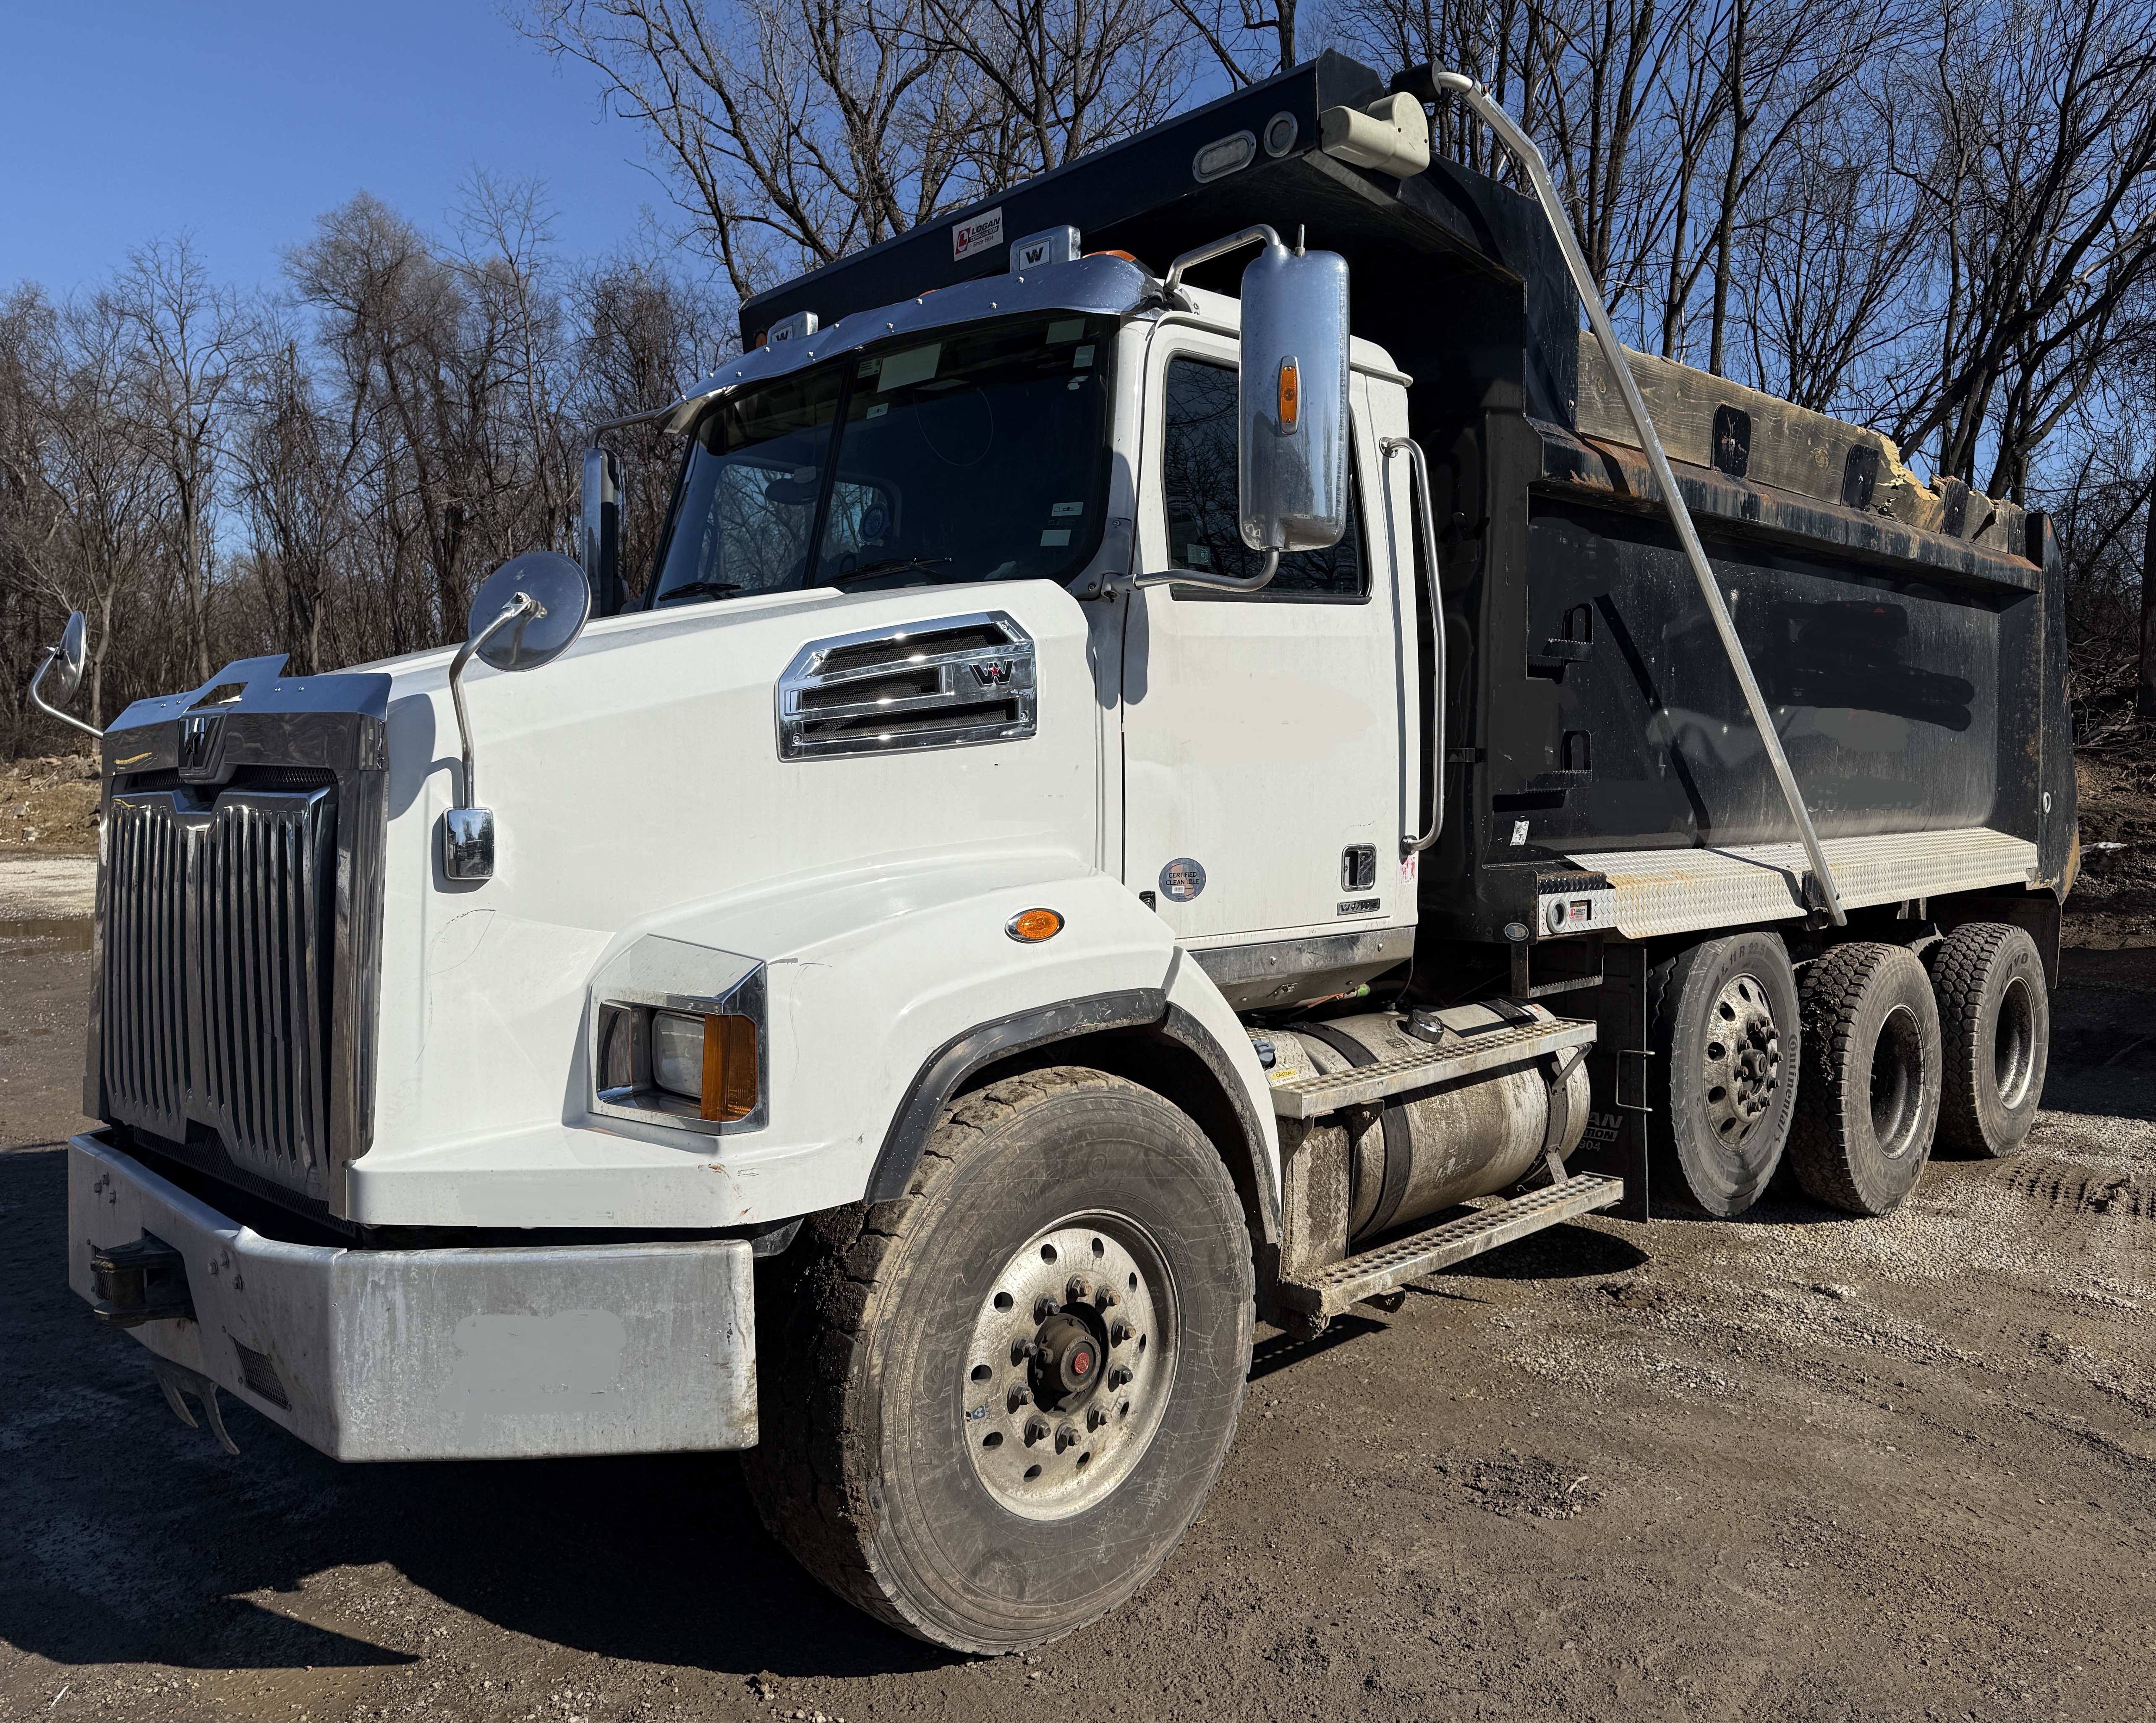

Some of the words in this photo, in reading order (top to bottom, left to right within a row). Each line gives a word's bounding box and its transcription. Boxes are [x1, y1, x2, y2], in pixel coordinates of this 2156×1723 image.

[970, 227, 997, 242] CORPORATION
[972, 217, 1001, 235] LOGAN
[1729, 951, 1736, 965] 11
[1739, 945, 1745, 958] R
[1748, 942, 1765, 956] 22.5
[1998, 952, 2028, 997] TOYO
[1777, 1033, 1798, 1134] Continental
[1588, 1111, 1623, 1129] AN
[1578, 1139, 1600, 1151] 904
